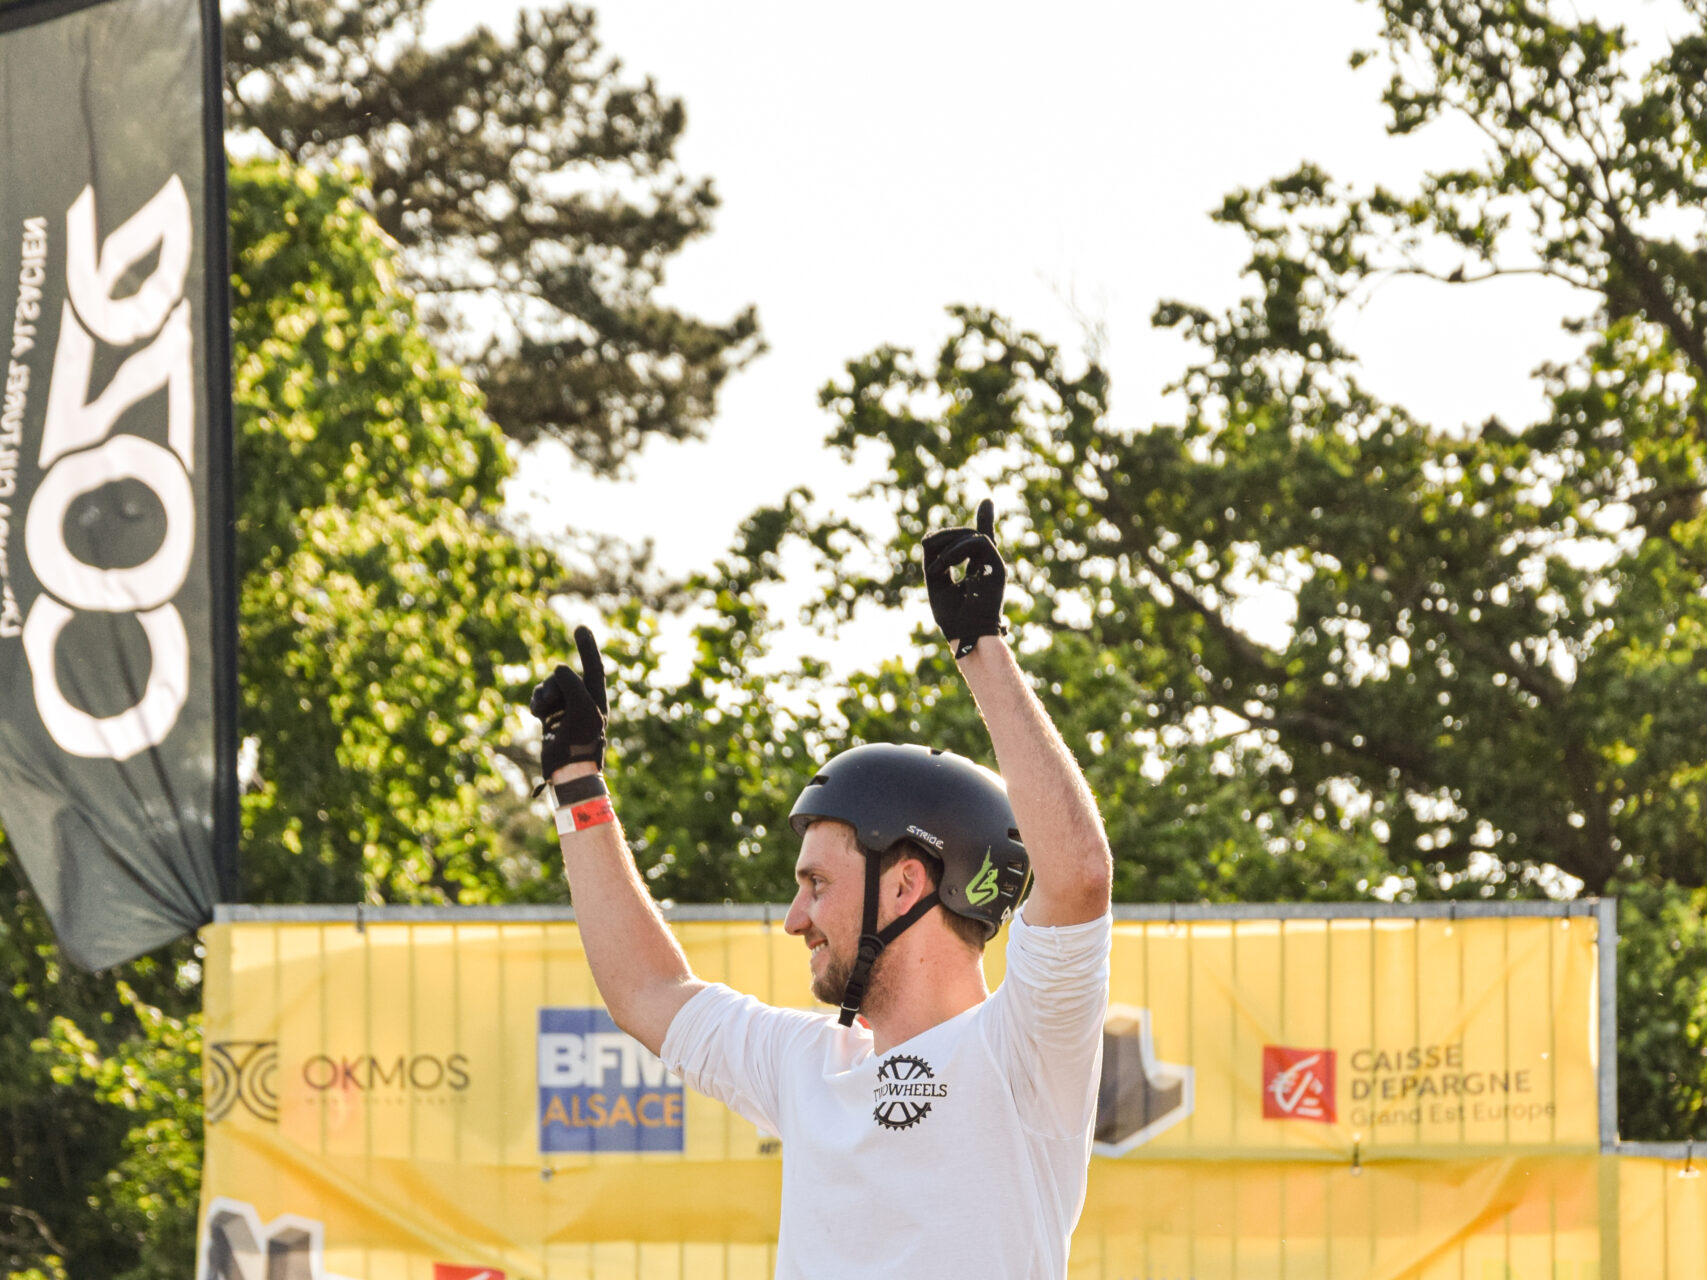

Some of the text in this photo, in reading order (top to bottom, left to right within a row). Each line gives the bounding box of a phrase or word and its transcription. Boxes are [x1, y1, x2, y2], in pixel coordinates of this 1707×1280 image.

[303, 1054, 470, 1091] OKMOS
[1350, 1045, 1462, 1073] CAISSE
[543, 1093, 683, 1128] ALSACE
